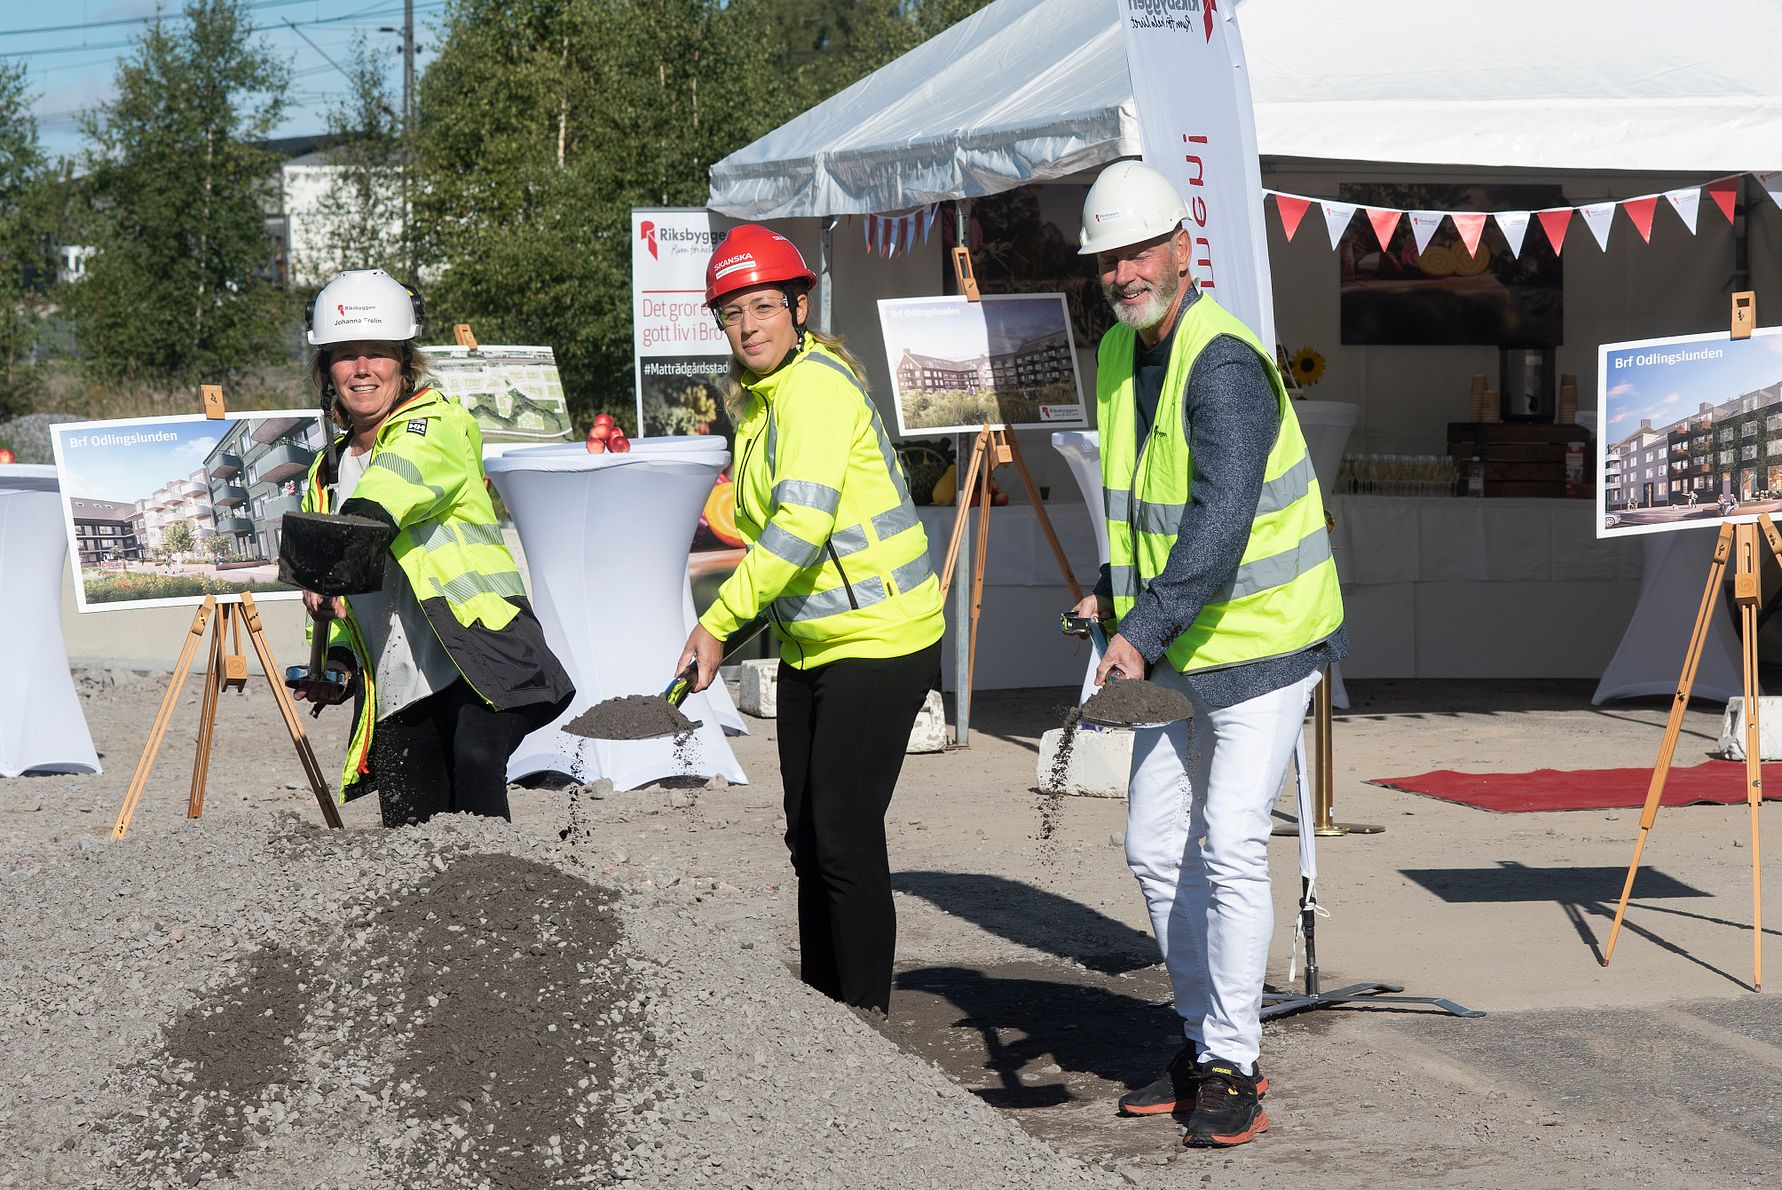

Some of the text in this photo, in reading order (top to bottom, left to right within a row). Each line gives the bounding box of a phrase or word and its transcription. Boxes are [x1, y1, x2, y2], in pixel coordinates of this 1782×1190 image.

[660, 228, 727, 244] Riksbygge
[714, 252, 753, 271] SKANSKA
[642, 298, 667, 318] Det
[669, 302, 699, 322] gror
[334, 317, 362, 326] Johanna
[642, 324, 671, 347] gott
[673, 322, 690, 341] liv
[699, 322, 723, 341] Bro
[1615, 348, 1723, 369] Brf Odlingslunden
[643, 361, 730, 377] #Matträdgårdsstad
[69, 431, 178, 448] Brf Odlingslunden
